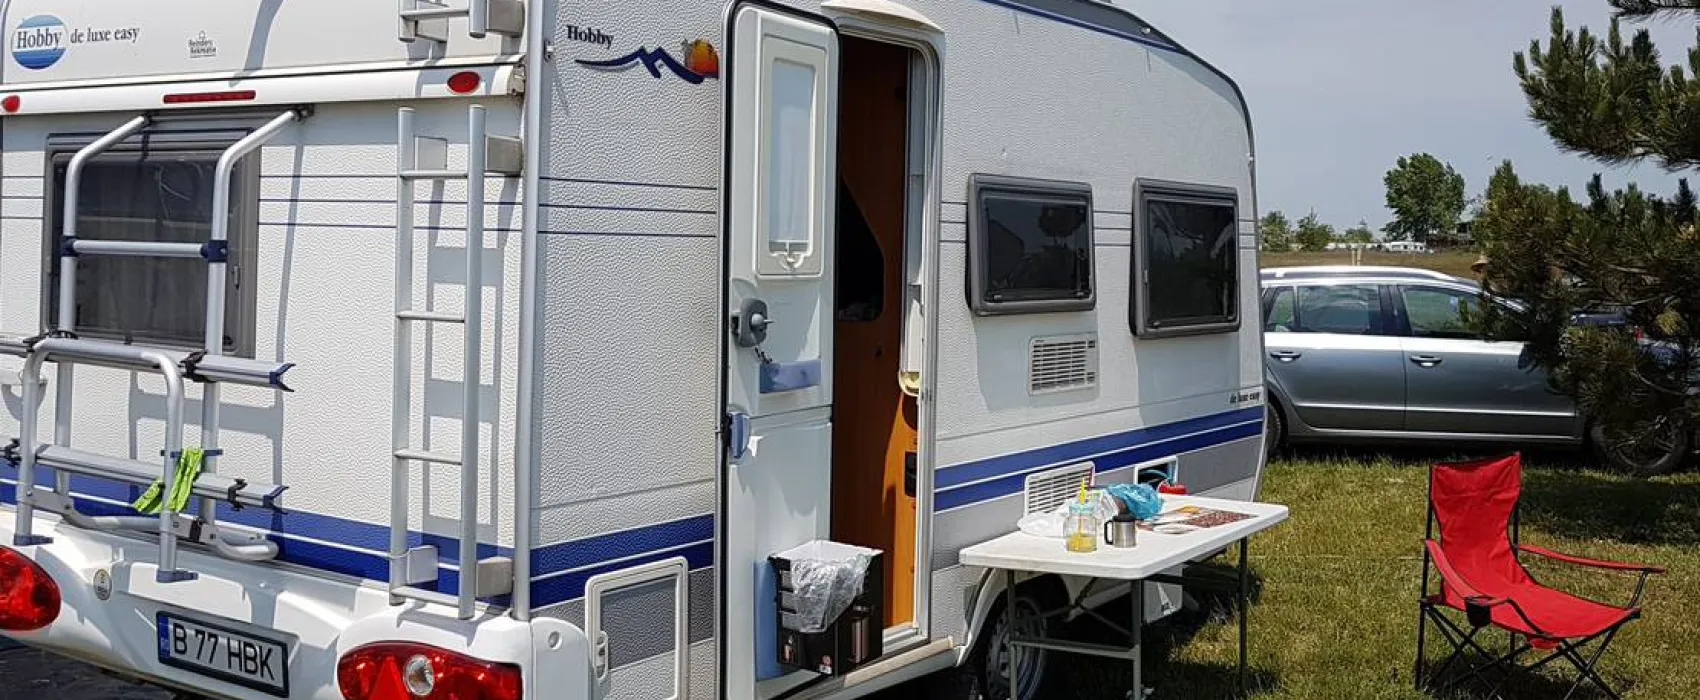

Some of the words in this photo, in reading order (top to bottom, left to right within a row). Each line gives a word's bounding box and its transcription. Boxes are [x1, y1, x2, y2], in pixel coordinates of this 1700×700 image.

[17, 27, 62, 51] Hobby
[70, 28, 85, 43] de
[86, 27, 112, 42] luxe
[114, 27, 140, 43] easy
[566, 24, 614, 49] Hobby
[172, 622, 188, 655] B
[194, 628, 218, 664] 77
[227, 635, 275, 681] HBK
